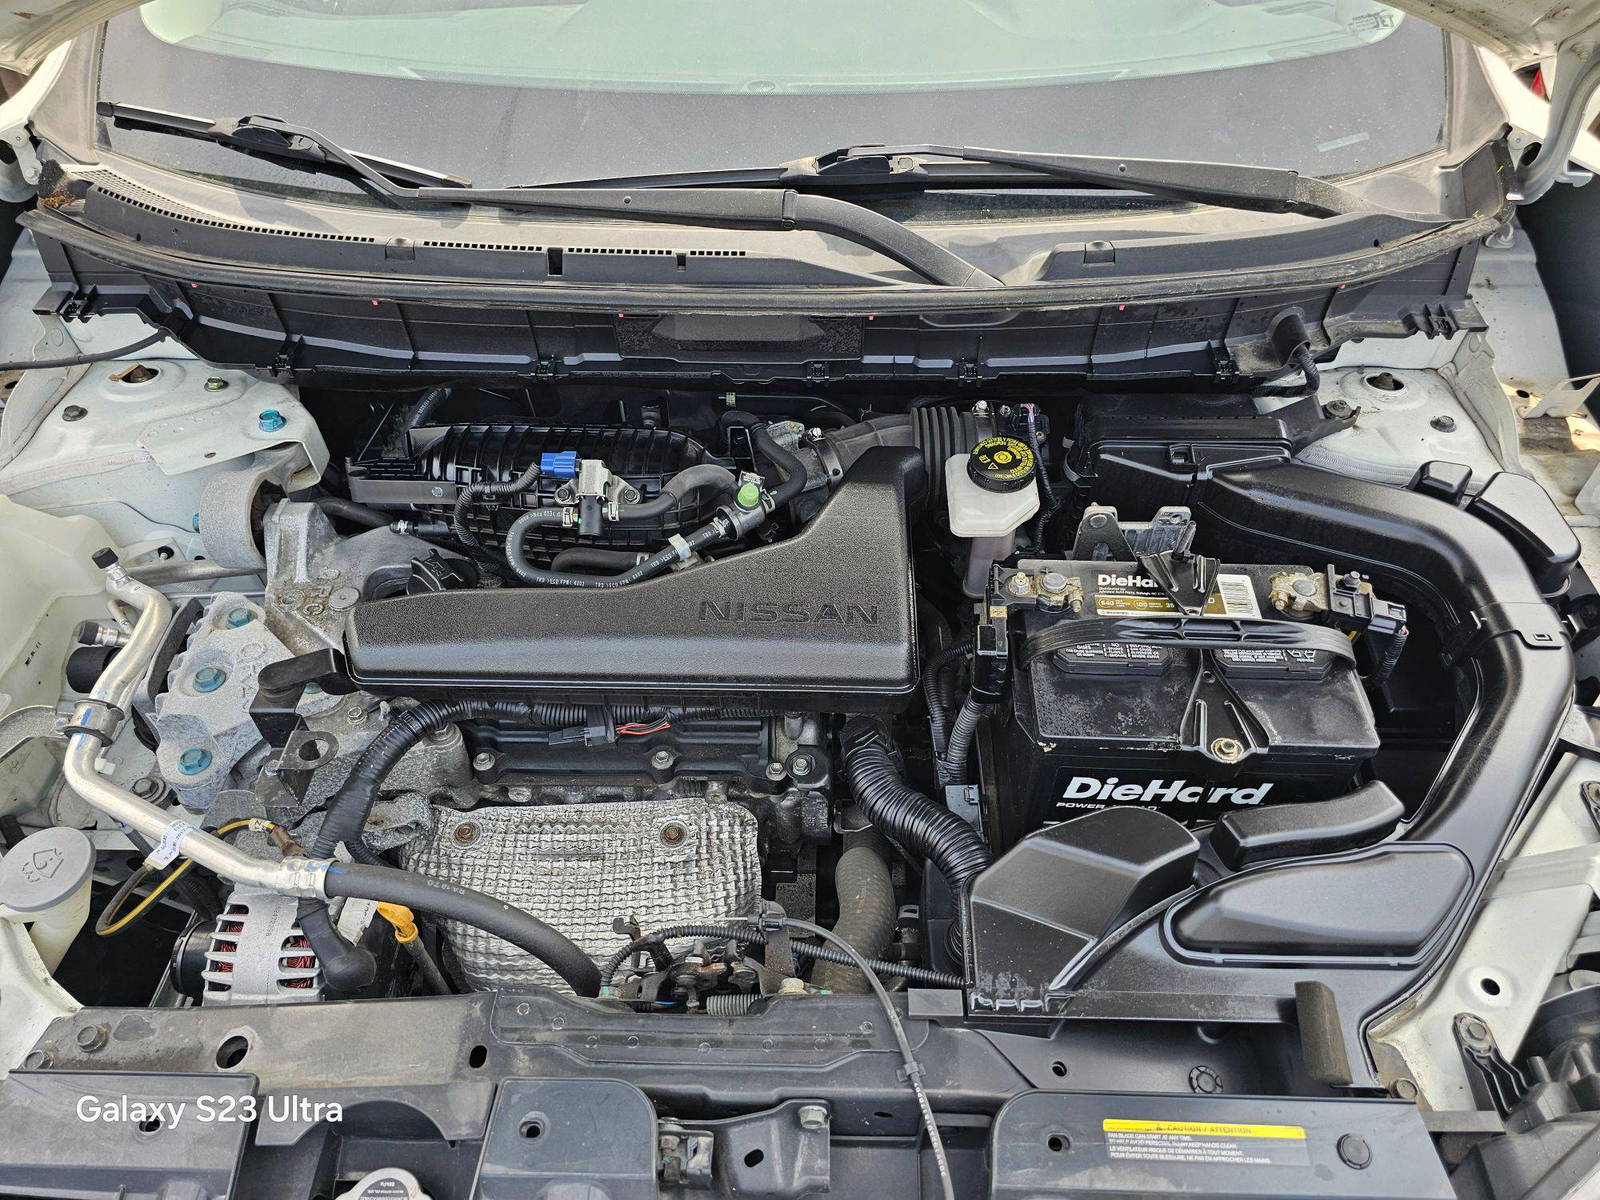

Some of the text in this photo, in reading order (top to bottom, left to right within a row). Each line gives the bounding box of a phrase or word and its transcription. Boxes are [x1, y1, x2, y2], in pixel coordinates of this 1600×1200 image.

[1097, 574, 1160, 588] DieHa
[699, 601, 878, 627] NISSAN
[1063, 776, 1275, 806] DieHard
